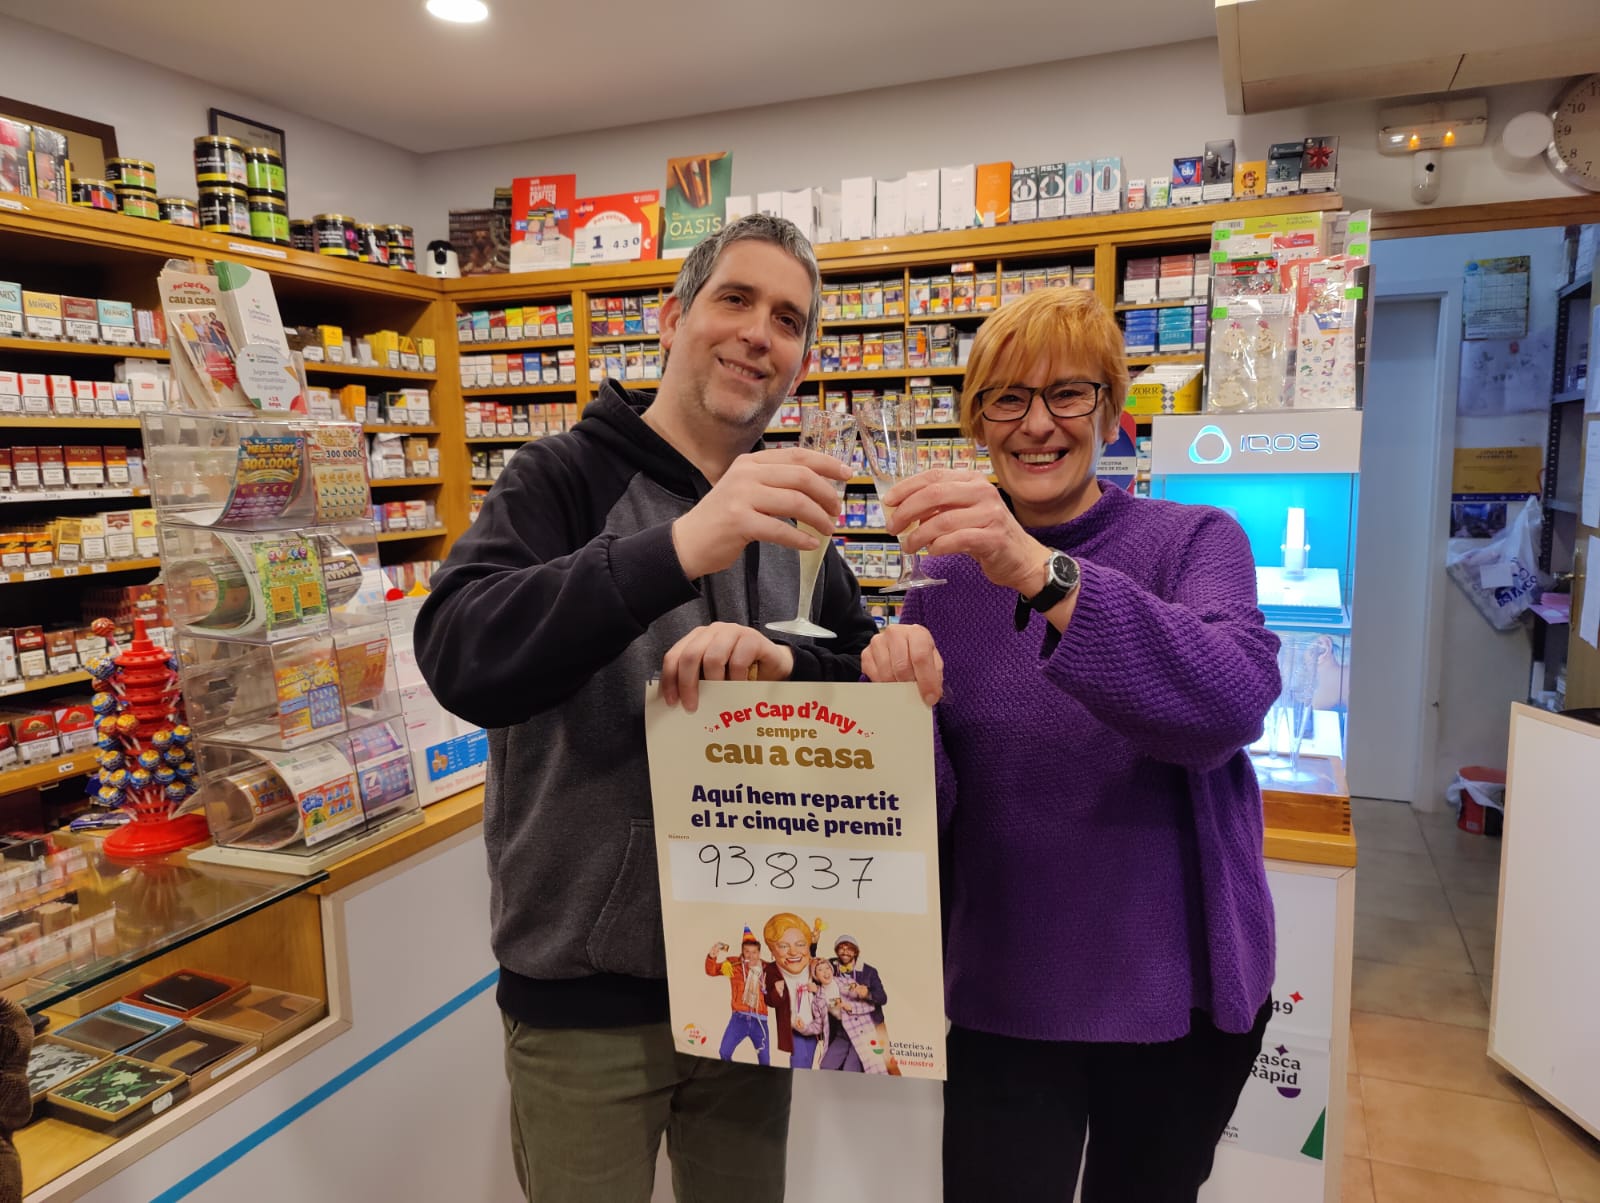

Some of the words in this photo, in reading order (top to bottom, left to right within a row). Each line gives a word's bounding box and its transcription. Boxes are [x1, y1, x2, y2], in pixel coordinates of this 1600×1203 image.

[1571, 103, 1585, 114] 10
[1564, 124, 1572, 136] 9
[1570, 149, 1578, 158] 8
[1585, 161, 1592, 171] 7
[669, 217, 722, 237] OASIS
[593, 235, 604, 250] 1
[169, 295, 187, 304] cau
[187, 296, 194, 304] a
[195, 297, 217, 306] casa
[1240, 433, 1321, 454] IQOS
[755, 701, 795, 721] Cap
[797, 700, 857, 734] d'Any
[756, 726, 818, 741] sempre
[705, 743, 763, 765] cau
[769, 745, 790, 766] a
[794, 746, 875, 770] casa
[691, 784, 744, 807] Aquí
[746, 786, 797, 806] hem
[800, 790, 900, 812] repartit
[691, 809, 711, 828] el
[715, 811, 738, 829] 1r
[742, 810, 820, 836] cinquè
[823, 816, 903, 837] premi!
[698, 844, 875, 899] 93.837
[889, 1040, 925, 1050] Loteries
[889, 1048, 934, 1060] Catalunya
